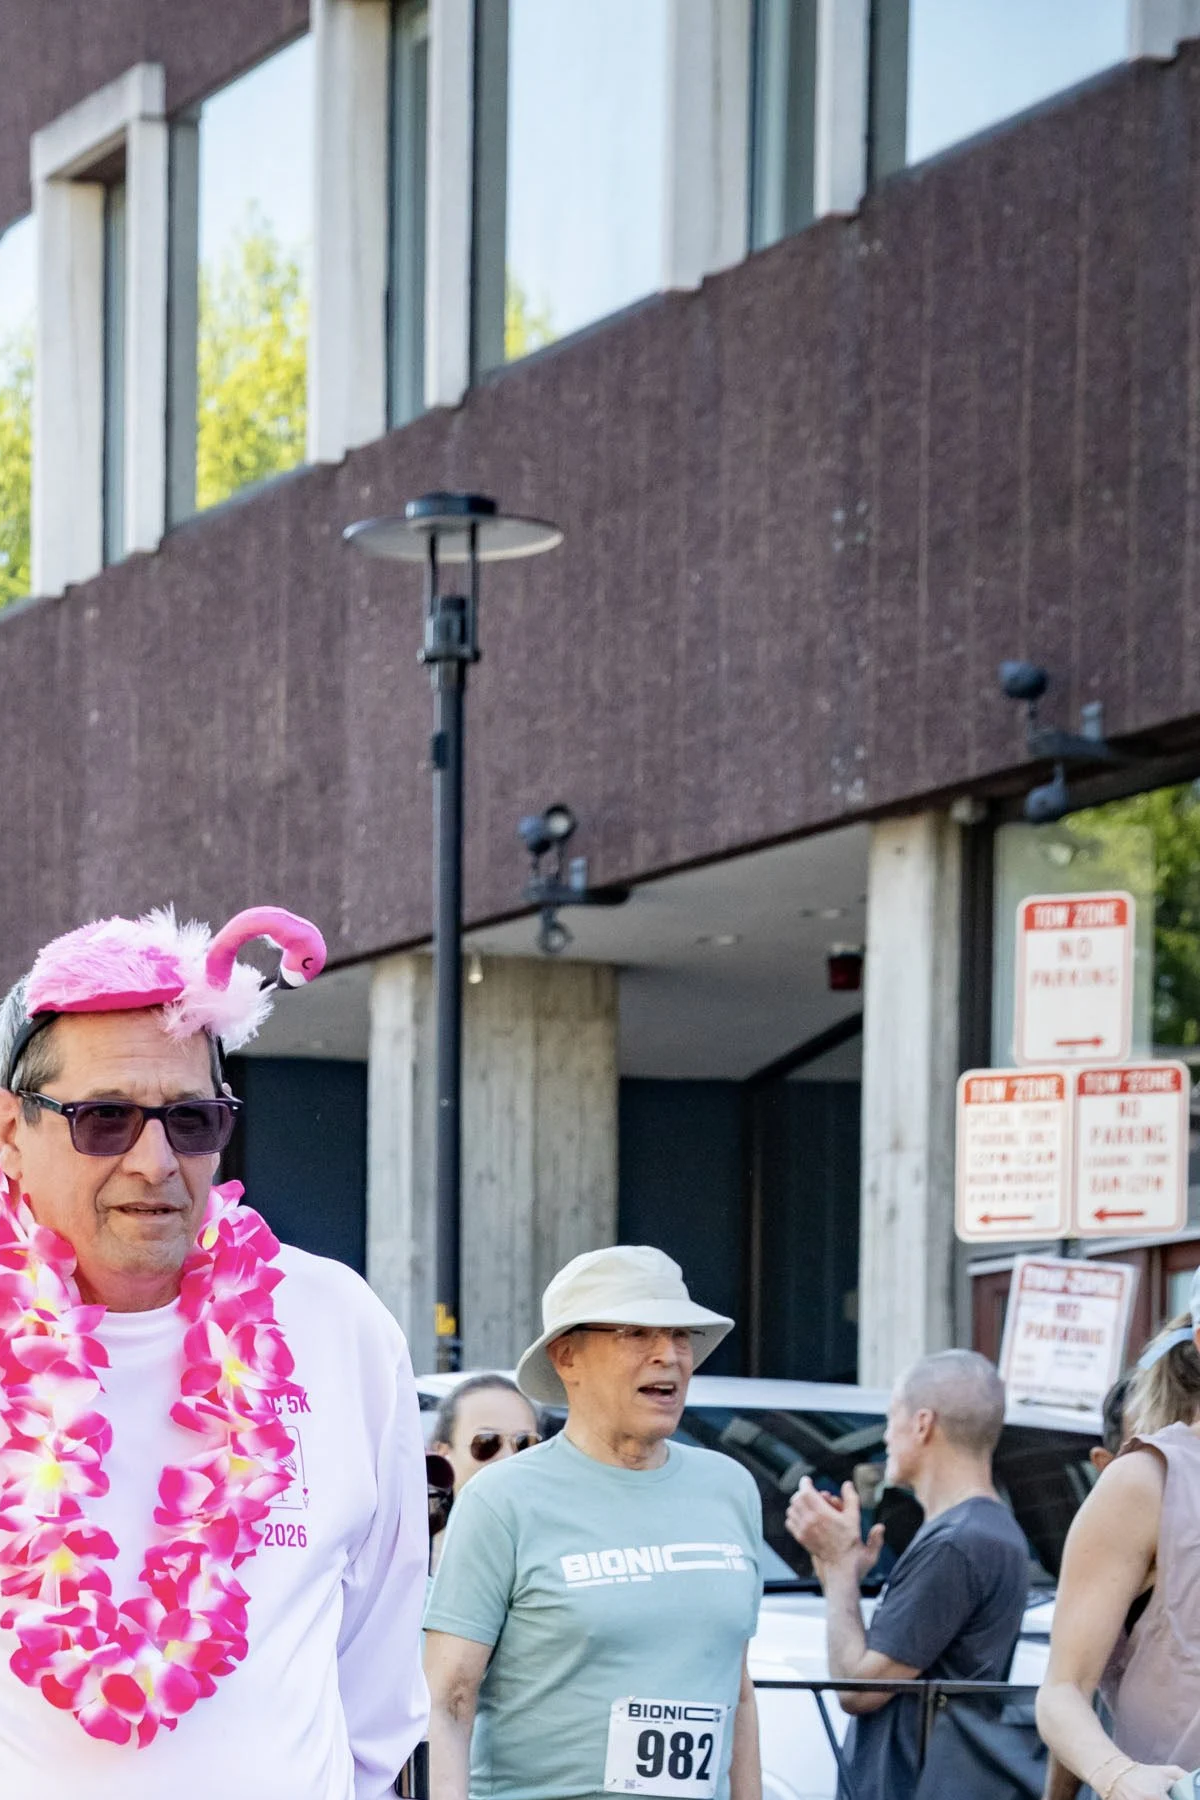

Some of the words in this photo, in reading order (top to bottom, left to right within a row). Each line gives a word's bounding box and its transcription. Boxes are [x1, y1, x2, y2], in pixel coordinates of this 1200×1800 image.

[1034, 903, 1070, 928] TOW
[1073, 902, 1117, 926] ZONE
[1059, 937, 1092, 961] NO
[1031, 966, 1118, 987] PARKING
[971, 1080, 1006, 1103] TOW
[1013, 1078, 1059, 1102] ZONE
[1119, 1100, 1141, 1118] NO
[1090, 1125, 1167, 1145] PARKING
[264, 1523, 308, 1548] 2026
[560, 1543, 725, 1582] BIONIC
[628, 1703, 714, 1722] BIONIC
[636, 1729, 714, 1781] 982
